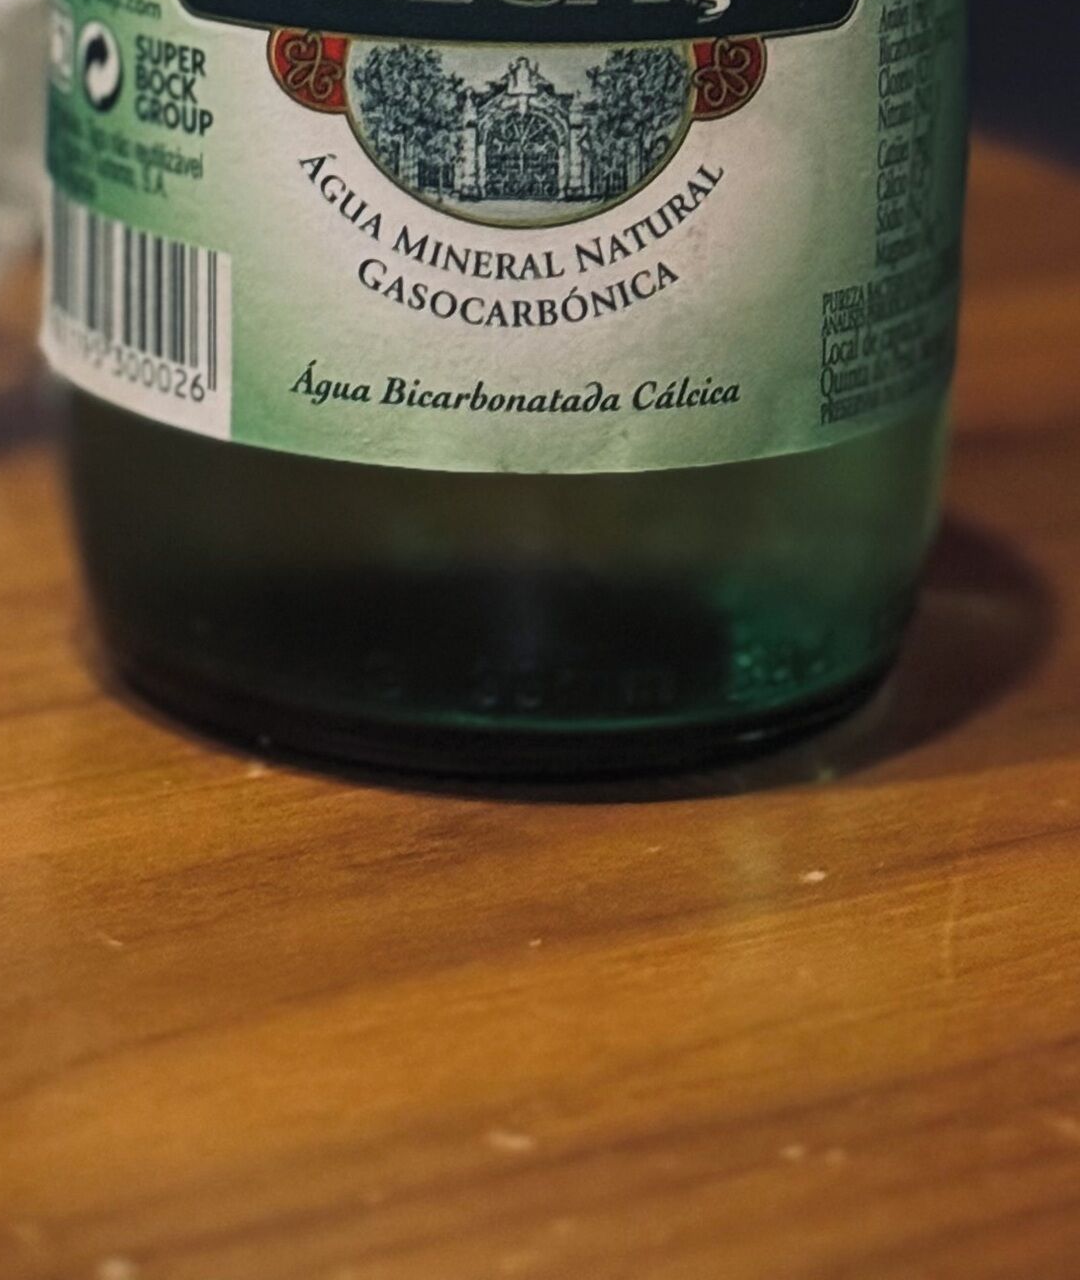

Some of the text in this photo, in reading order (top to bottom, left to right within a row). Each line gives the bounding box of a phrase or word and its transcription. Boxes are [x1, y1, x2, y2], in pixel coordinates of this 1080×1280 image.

[135, 35, 207, 76] SUPER
[135, 66, 198, 104] BOCK
[135, 96, 214, 137] GROUP
[299, 153, 725, 281] ÁGUA MINERAL NATURAL
[357, 256, 679, 328] GASOCARBÓNICA
[290, 360, 741, 413] Água Bicarbonatada Cálcica
